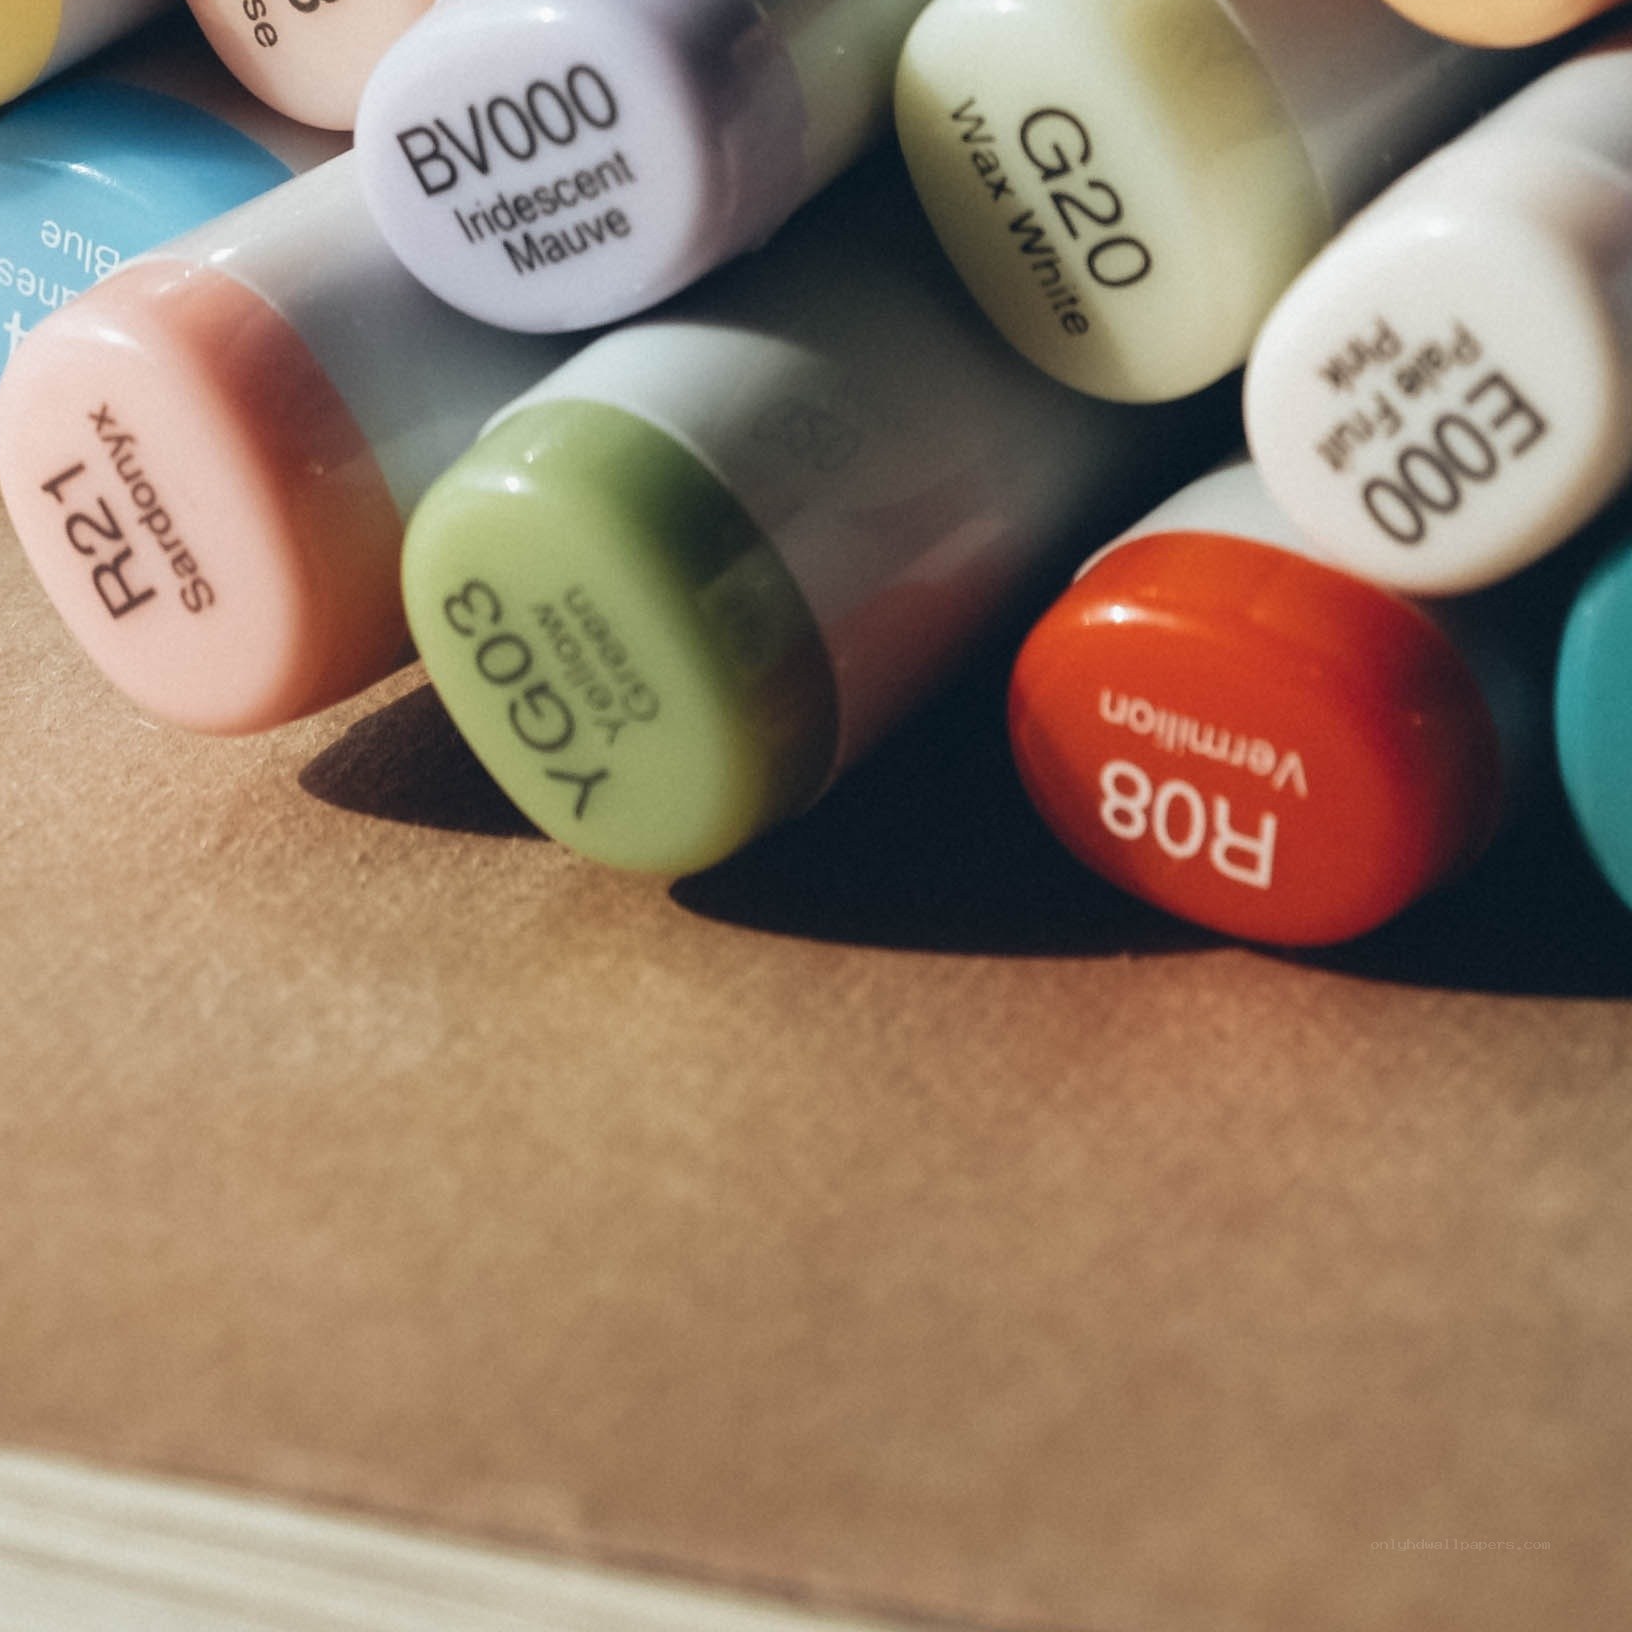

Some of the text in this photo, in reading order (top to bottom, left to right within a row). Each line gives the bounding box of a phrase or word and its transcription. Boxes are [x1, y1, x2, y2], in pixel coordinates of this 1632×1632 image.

[395, 63, 619, 197] BV000
[452, 150, 638, 244] Iridescent
[1018, 107, 1153, 291] G20
[40, 220, 120, 279] Blue
[502, 207, 631, 276] Mauve
[949, 97, 1090, 338] Wax White
[87, 402, 216, 615] Sardonyx
[1361, 371, 1551, 546] E000
[41, 460, 158, 620] R21
[443, 577, 609, 820] YG03
[531, 602, 625, 746] Yellow
[562, 582, 660, 723] Green
[1098, 687, 1309, 799] Vermilion
[1098, 759, 1278, 891] R08
